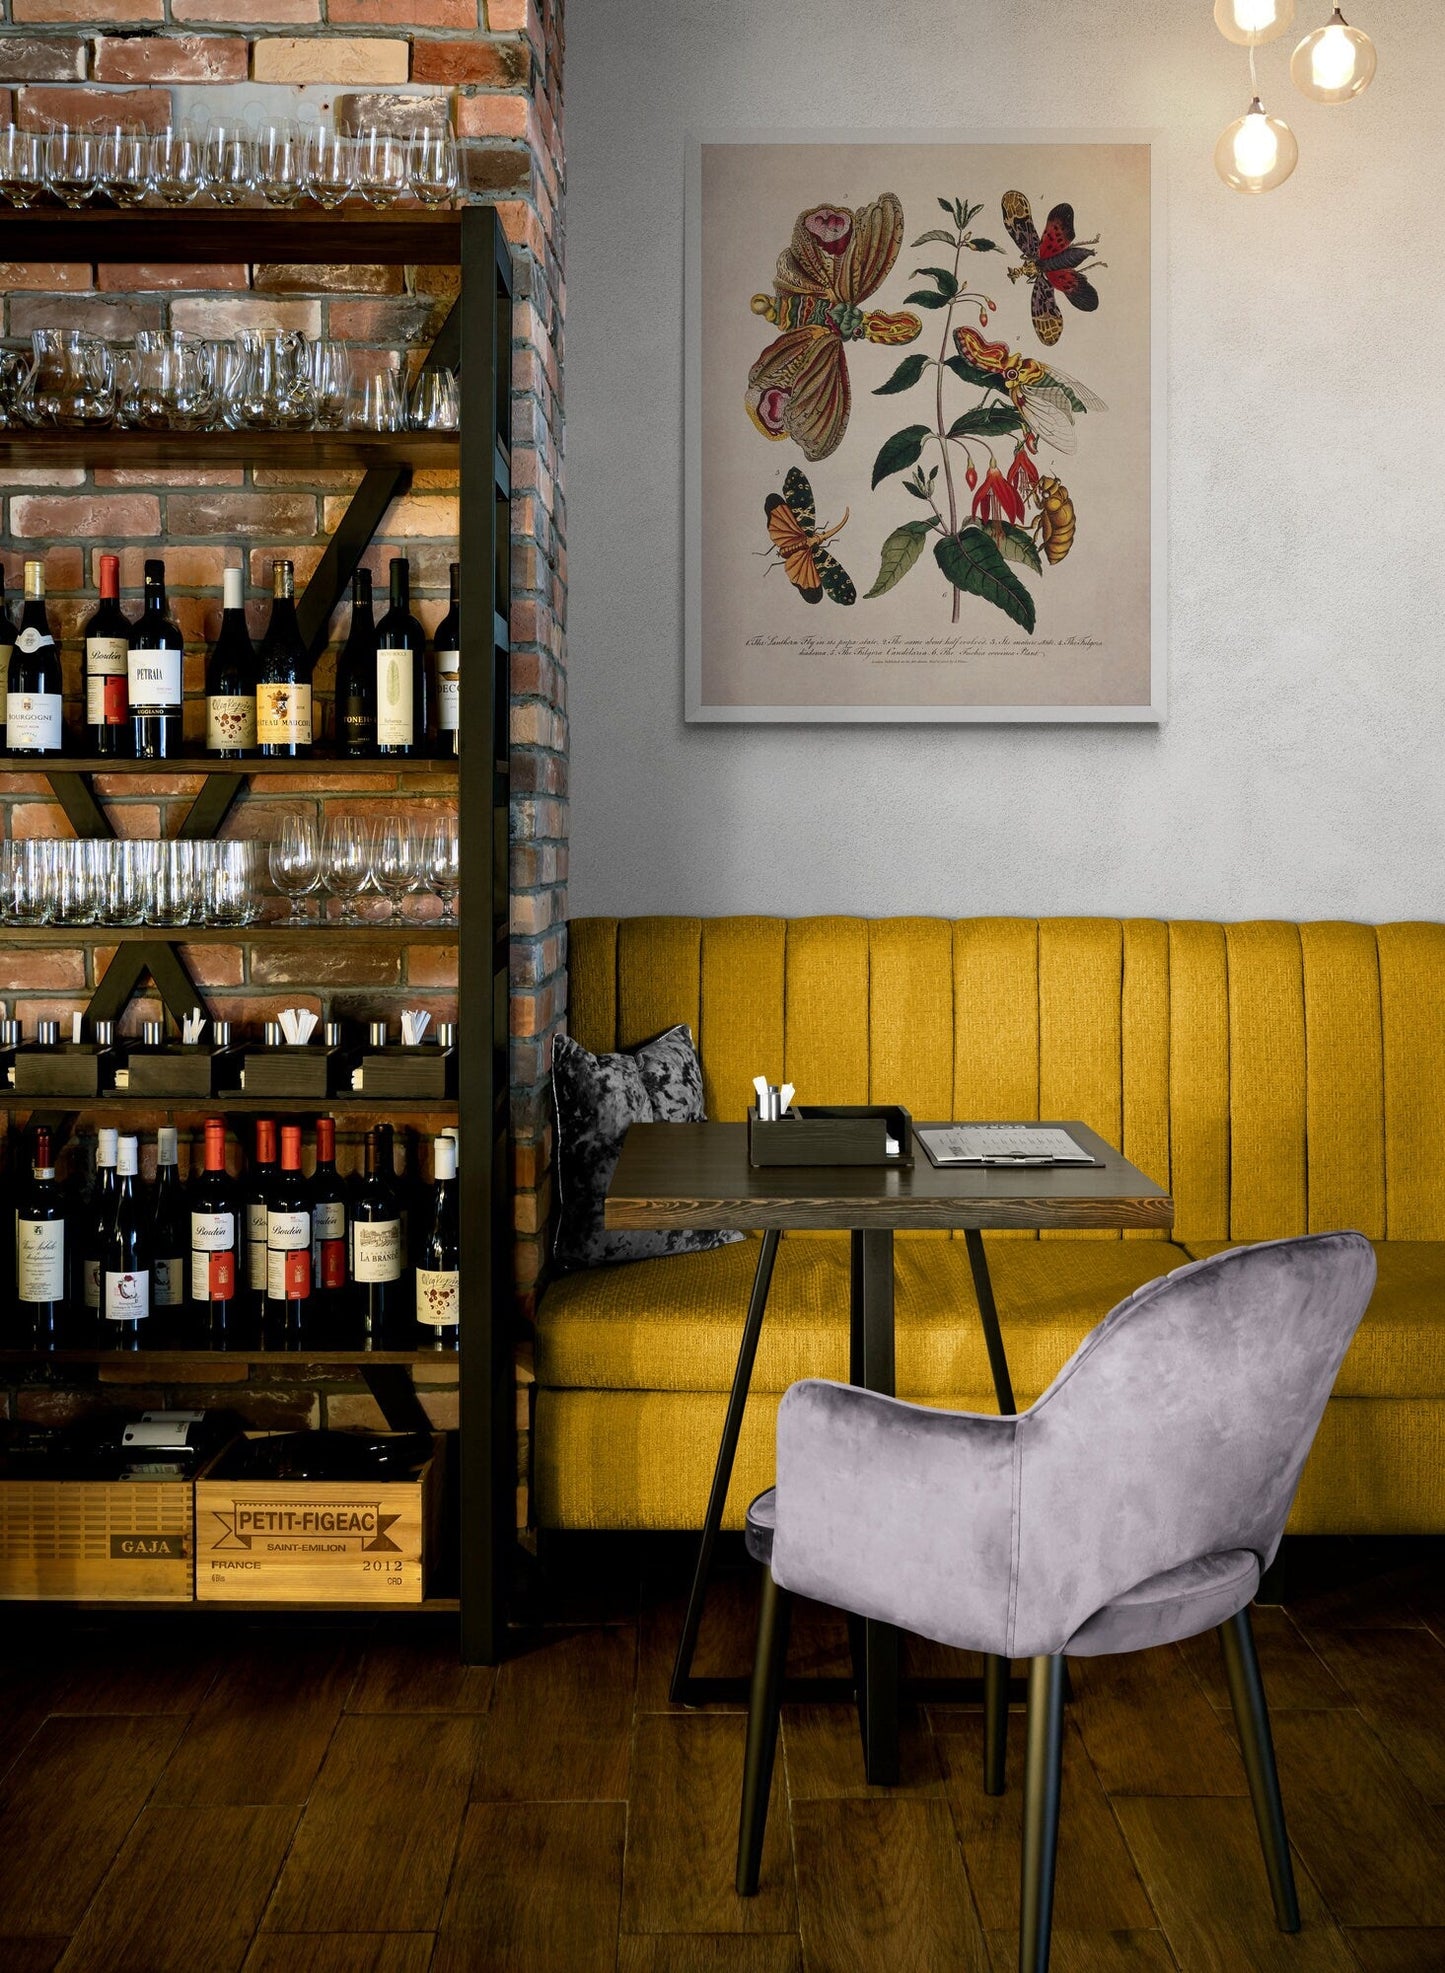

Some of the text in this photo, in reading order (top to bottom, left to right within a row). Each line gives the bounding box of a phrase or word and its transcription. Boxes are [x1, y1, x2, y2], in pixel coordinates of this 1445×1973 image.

[136, 668, 163, 680] PETRAIA
[239, 1511, 375, 1531] PETIT-FIGEAC
[121, 1540, 171, 1553] GAJA
[267, 1543, 346, 1552] SAINT-EMILION
[211, 1560, 403, 1571] FRANCE 2012
